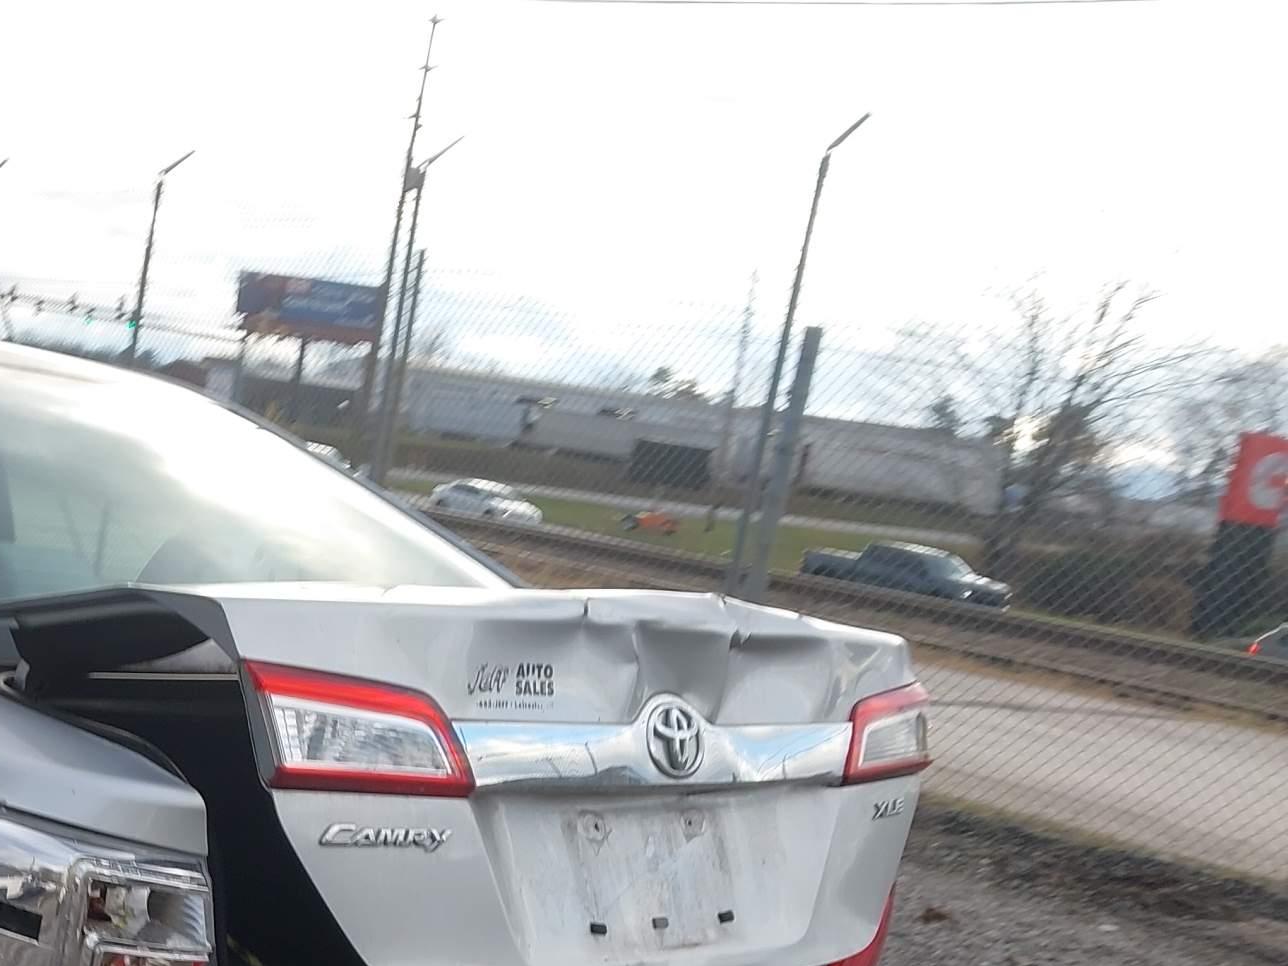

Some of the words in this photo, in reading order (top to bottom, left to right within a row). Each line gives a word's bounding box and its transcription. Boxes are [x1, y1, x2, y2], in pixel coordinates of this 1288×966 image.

[515, 662, 554, 680] AUTO
[515, 680, 554, 697] SALES
[318, 822, 452, 853] CAMRY
